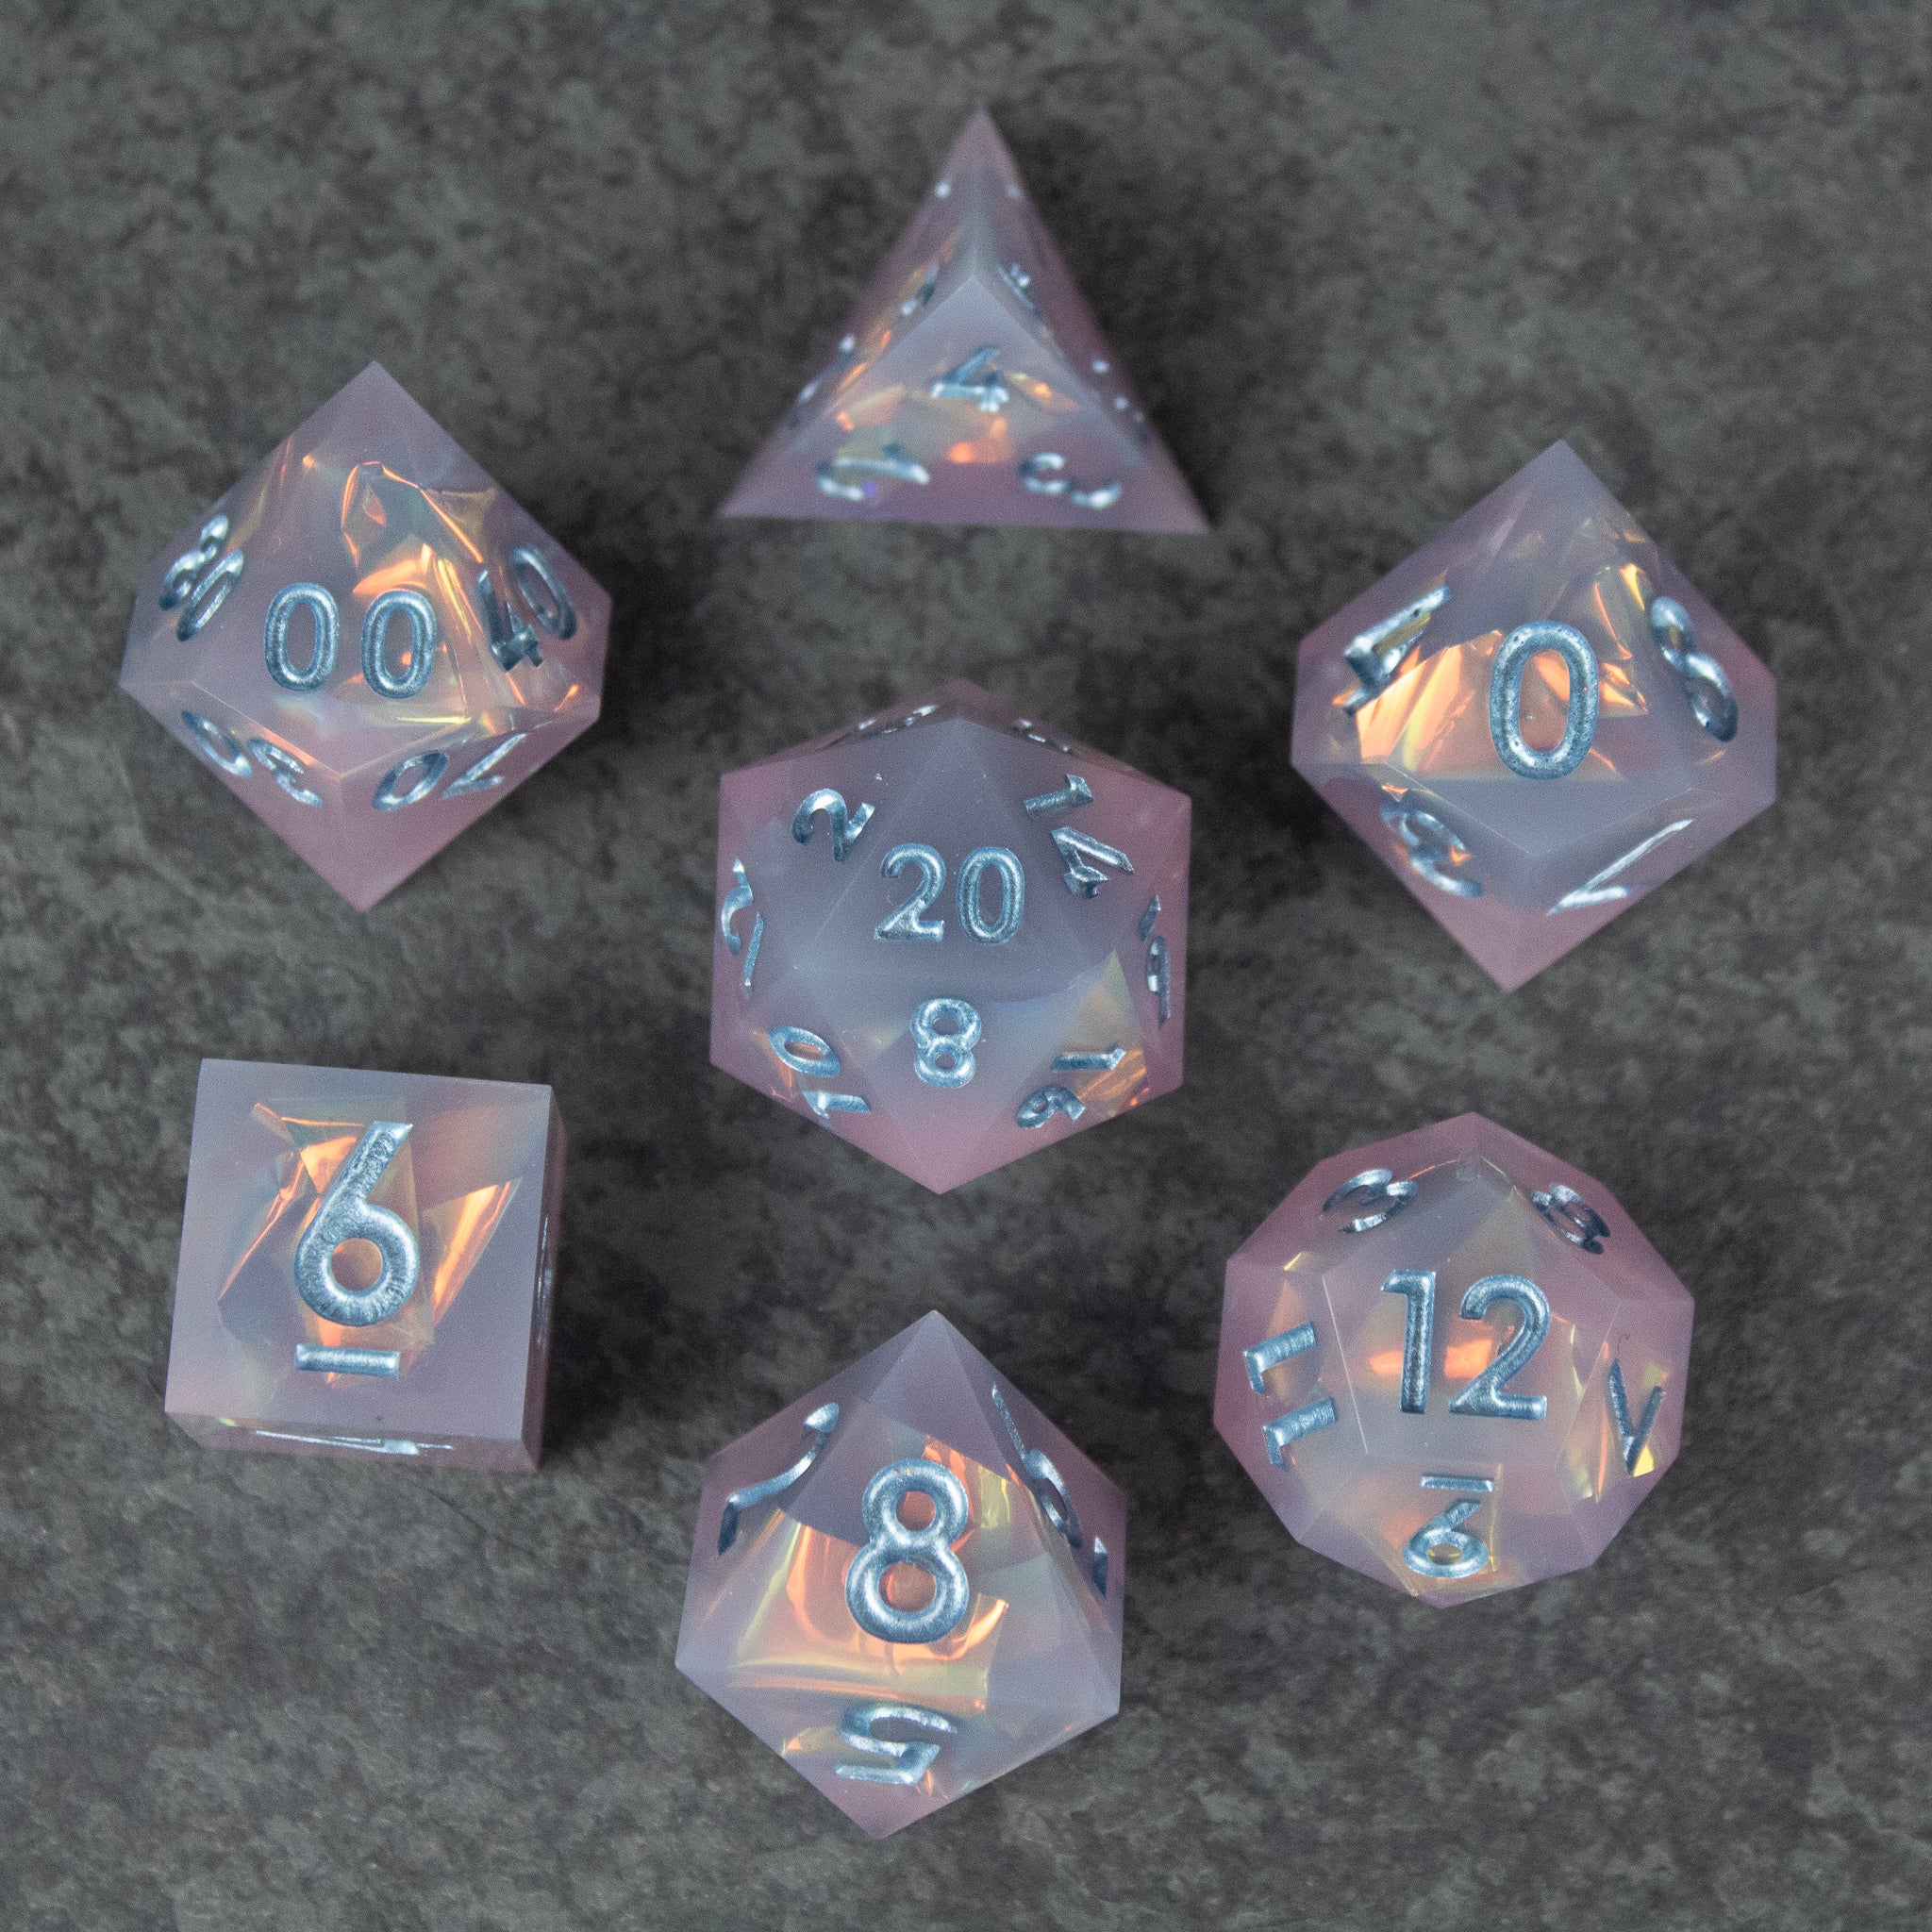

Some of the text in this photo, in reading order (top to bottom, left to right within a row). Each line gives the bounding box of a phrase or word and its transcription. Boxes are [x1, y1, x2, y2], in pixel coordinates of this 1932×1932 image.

[930, 345, 1008, 412] 4
[264, 581, 438, 699] 00
[478, 544, 577, 672] 40
[1651, 596, 1739, 743] 8
[1490, 621, 1599, 781] 0
[791, 788, 875, 863] 2
[1024, 774, 1134, 900] 14
[874, 843, 1025, 944] 20
[908, 998, 982, 1089] 8
[294, 1121, 422, 1327] 6
[1242, 1322, 1336, 1469] 11
[1380, 1270, 1552, 1422] 12
[717, 1402, 841, 1557] 2
[845, 1459, 970, 1644] 8
[835, 1706, 958, 1786] 5
